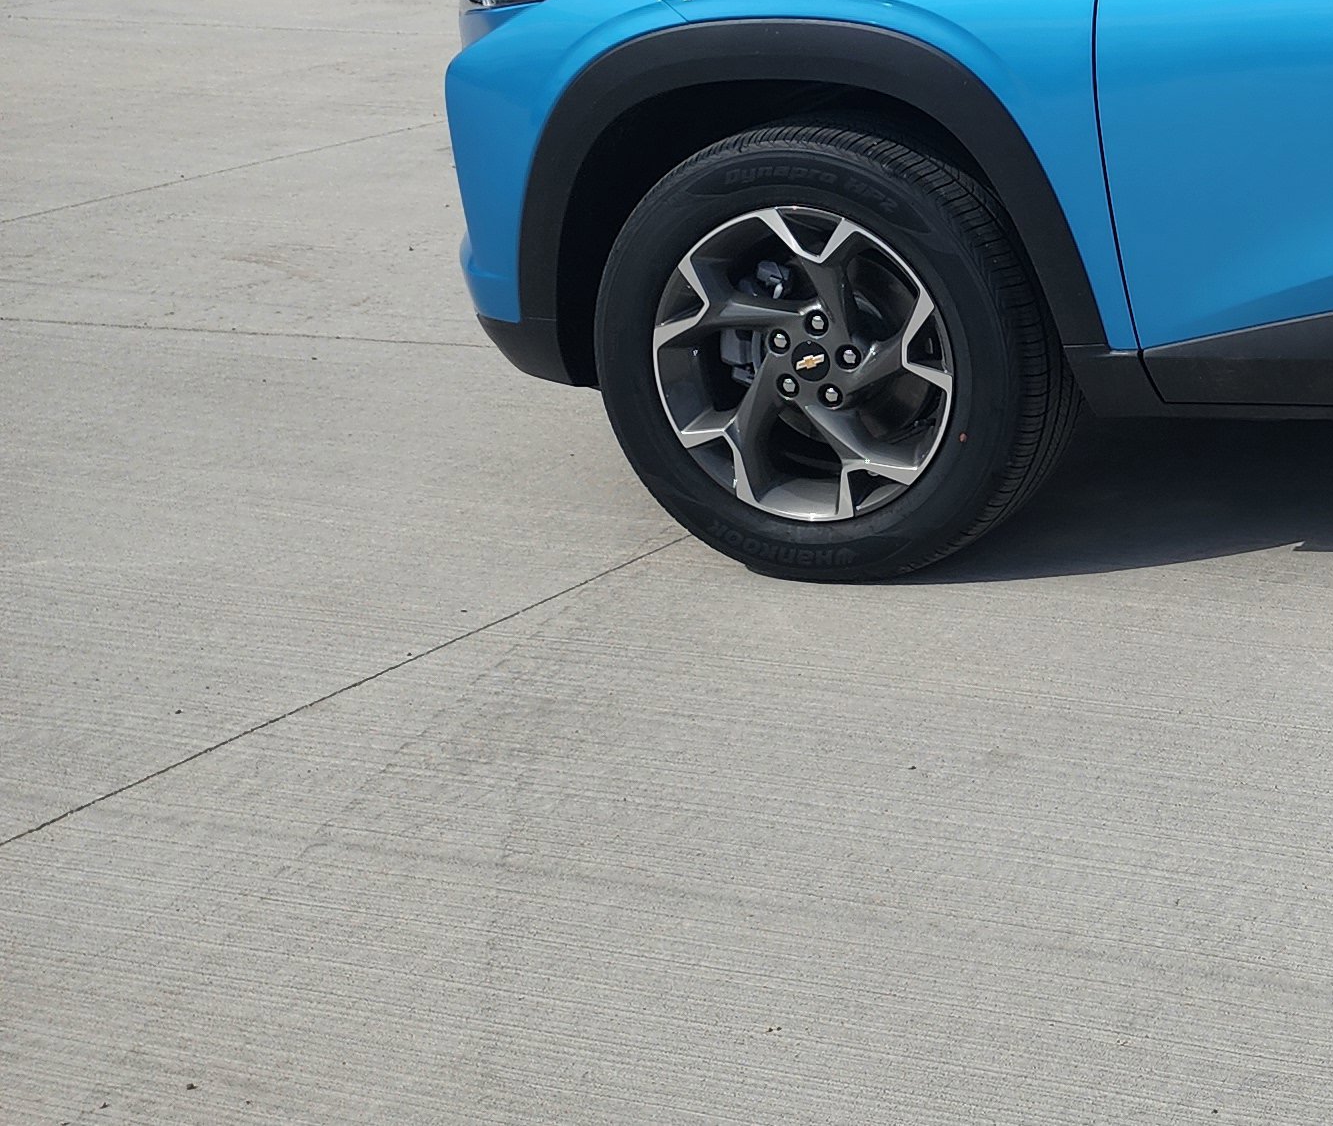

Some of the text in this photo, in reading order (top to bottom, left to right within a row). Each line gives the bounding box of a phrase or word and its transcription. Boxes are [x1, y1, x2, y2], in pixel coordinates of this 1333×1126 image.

[724, 165, 900, 214] Dynapro HP2
[704, 519, 834, 566] Hankook
